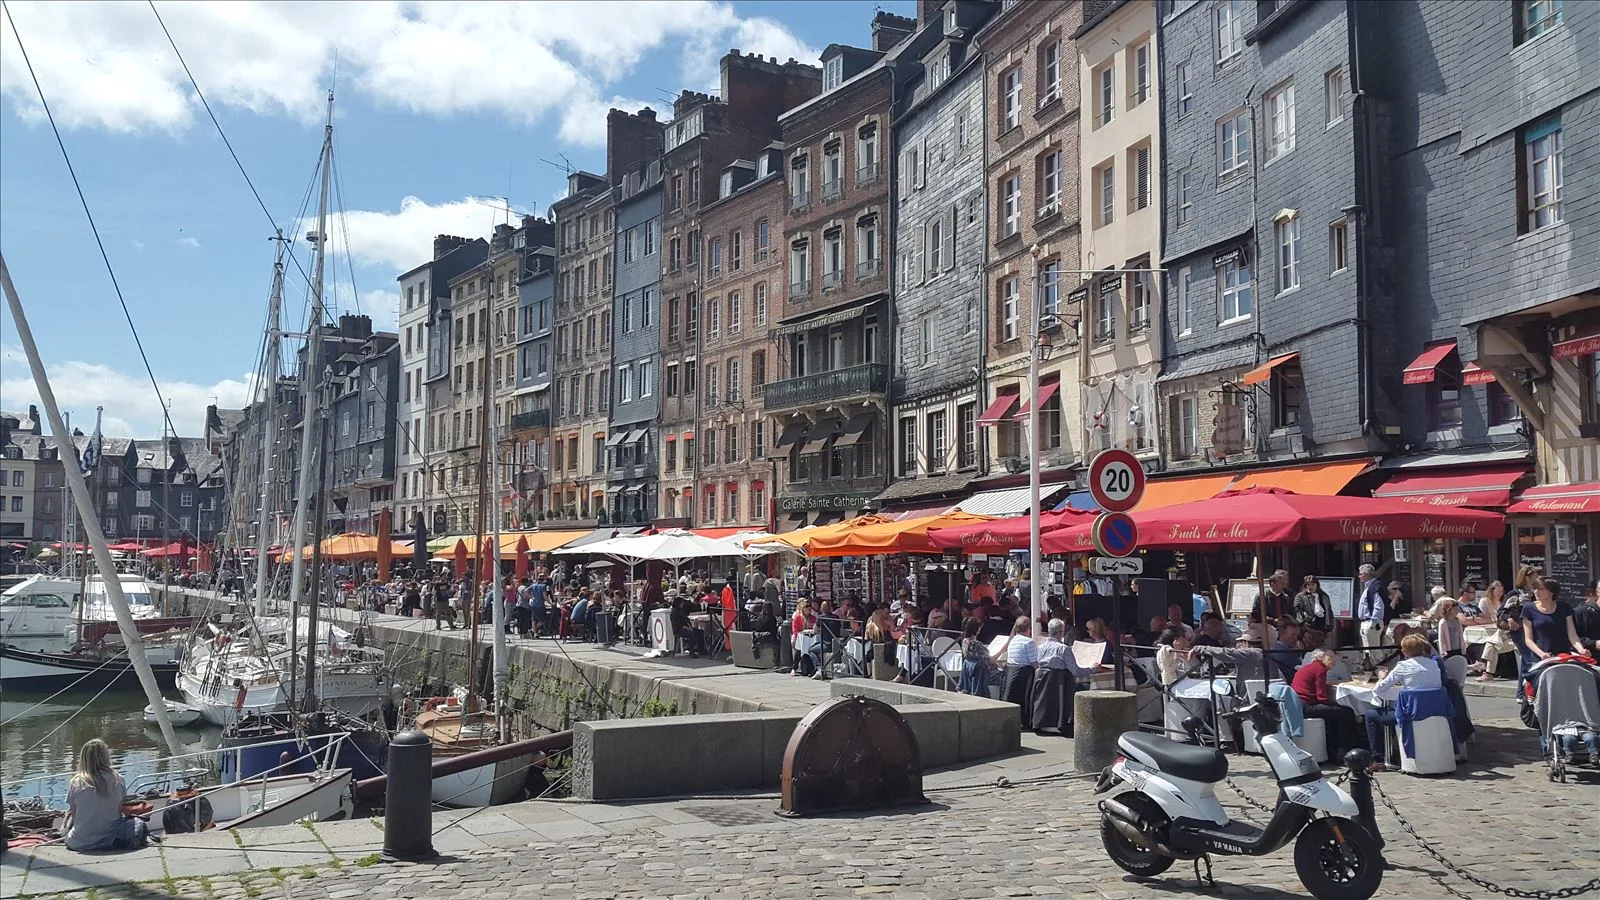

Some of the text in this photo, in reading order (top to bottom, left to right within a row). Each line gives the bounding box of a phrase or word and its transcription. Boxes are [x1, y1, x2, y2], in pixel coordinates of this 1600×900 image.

[1578, 342, 1587, 353] de
[1105, 468, 1130, 493] 20
[782, 495, 869, 510] Galerie Sainte Catherine
[1428, 494, 1468, 506] Bassin
[1528, 497, 1591, 510] Restaurant
[1168, 521, 1249, 539] Fruits de Mer
[1340, 517, 1477, 539] Crêperie Restaurant
[980, 529, 1014, 543] Bassin
[1213, 840, 1243, 854] YAMAHA
